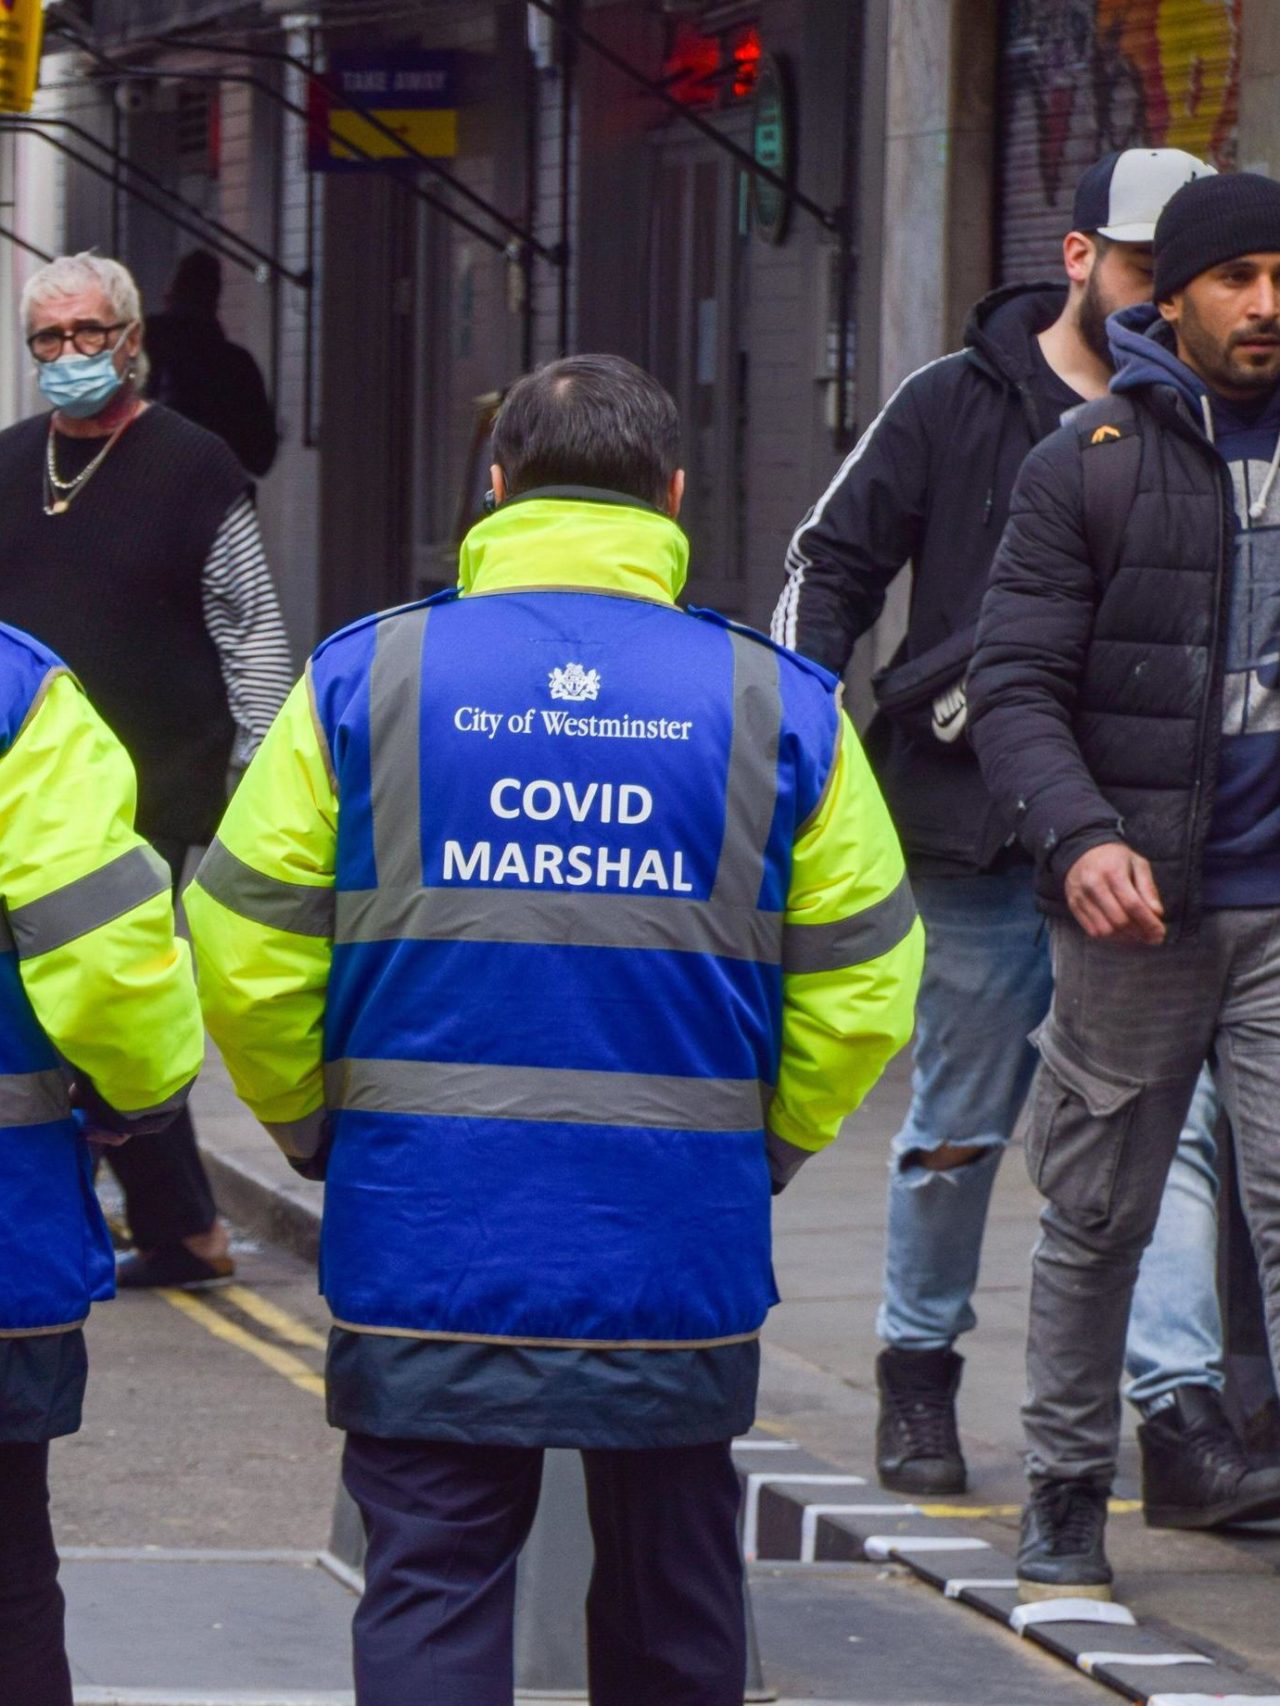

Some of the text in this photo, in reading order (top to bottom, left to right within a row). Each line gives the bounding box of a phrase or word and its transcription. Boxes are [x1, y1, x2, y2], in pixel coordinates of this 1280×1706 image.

[454, 706, 693, 740] City of Westminster
[490, 778, 653, 824] COVID
[443, 840, 692, 892] MARSHAL
